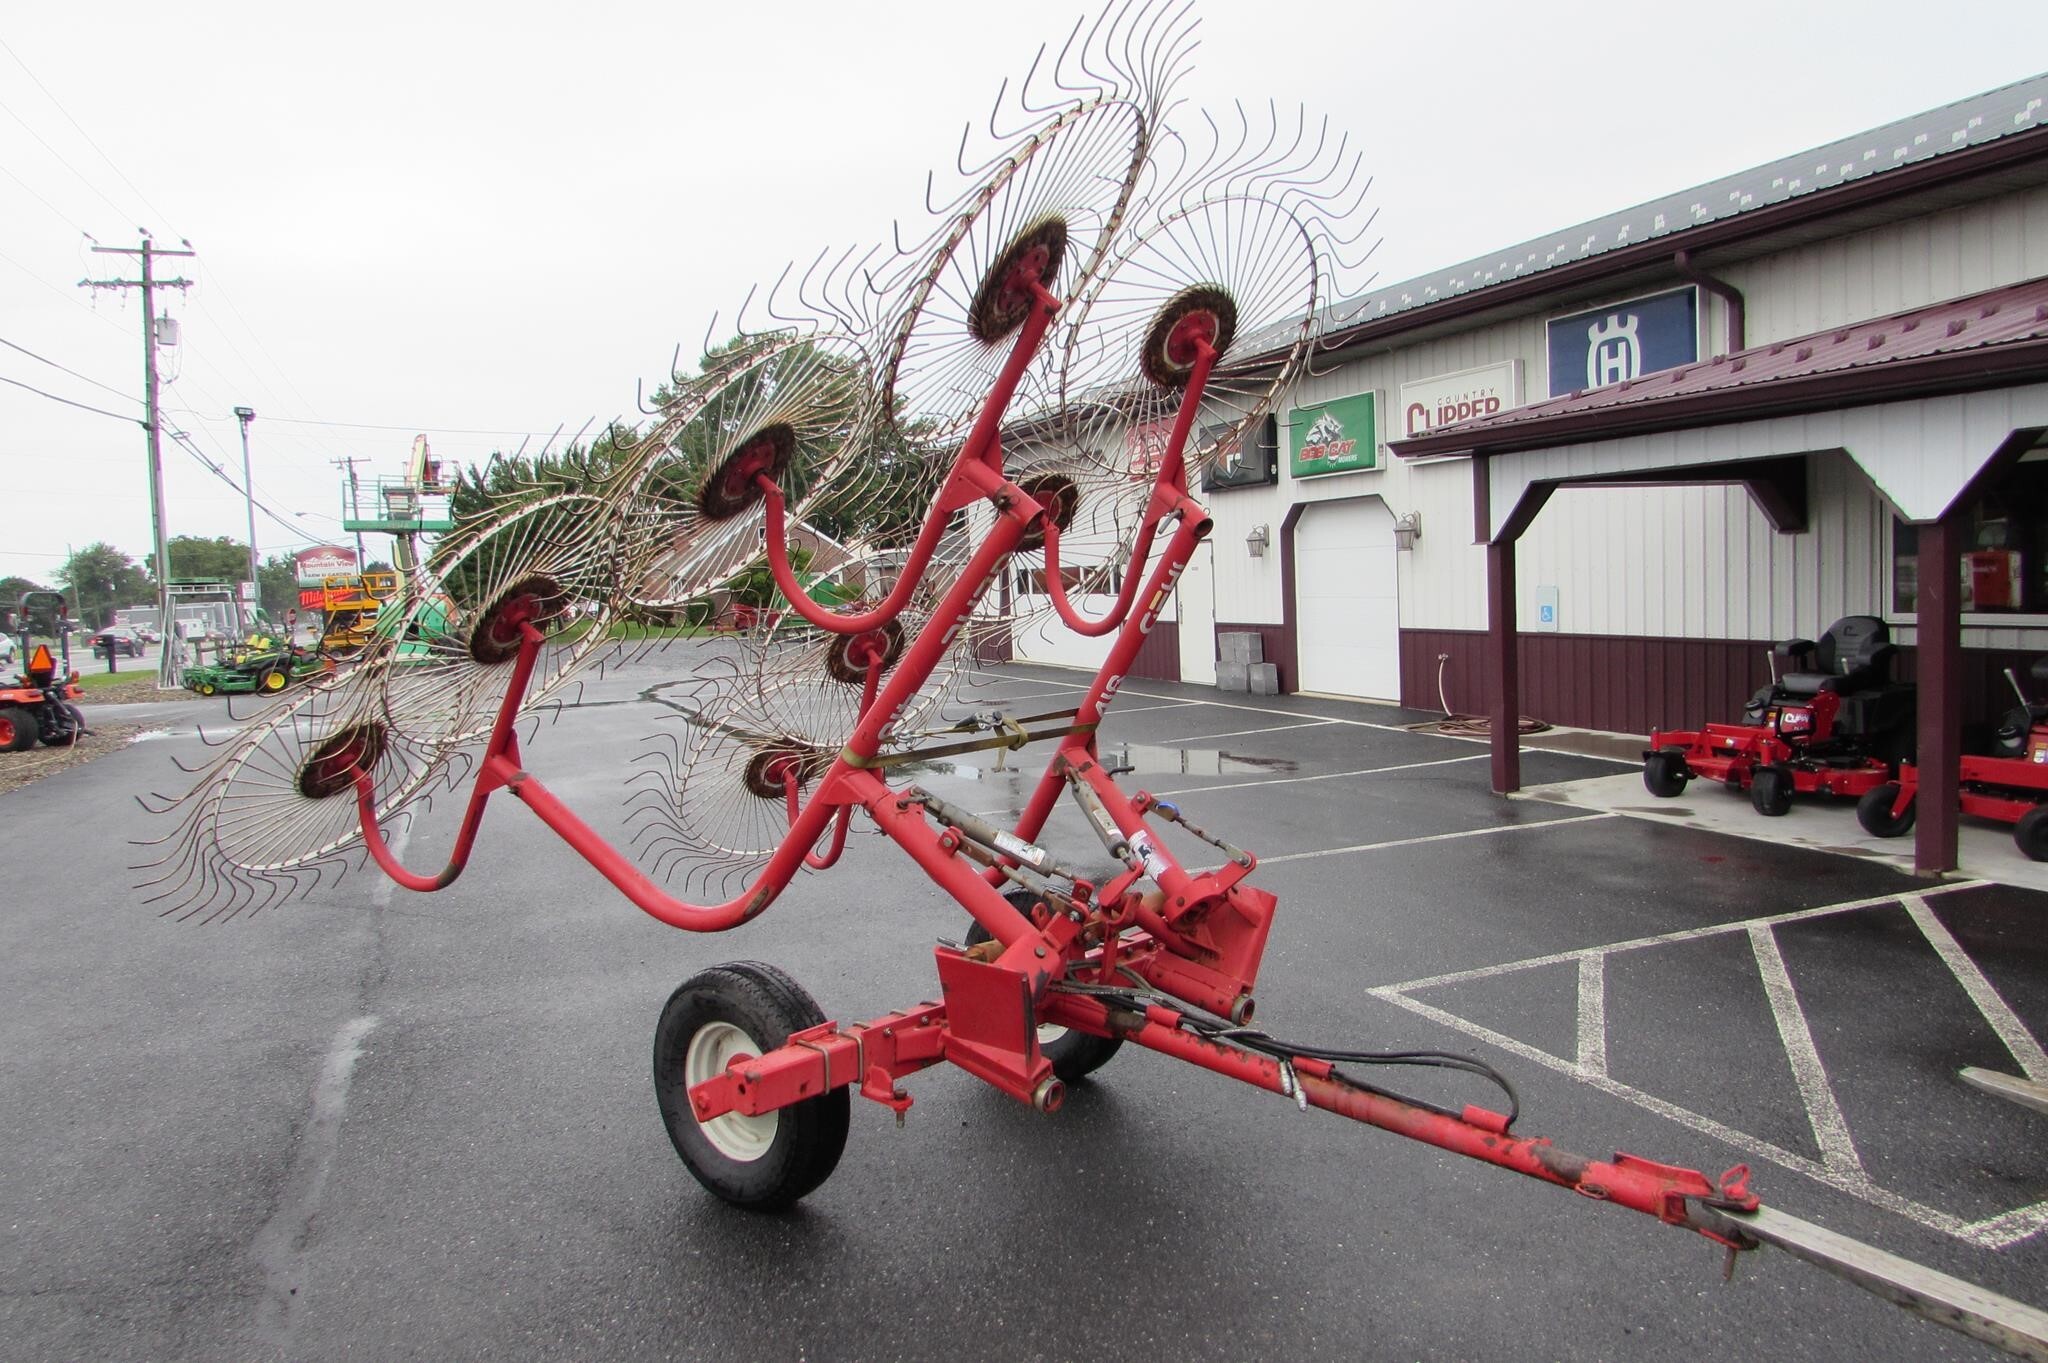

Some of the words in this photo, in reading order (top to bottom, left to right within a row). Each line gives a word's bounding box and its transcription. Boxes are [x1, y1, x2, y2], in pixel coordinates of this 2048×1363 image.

[1437, 387, 1495, 406] COUNTRY
[300, 561, 335, 569] Mountain
[336, 560, 355, 568] View
